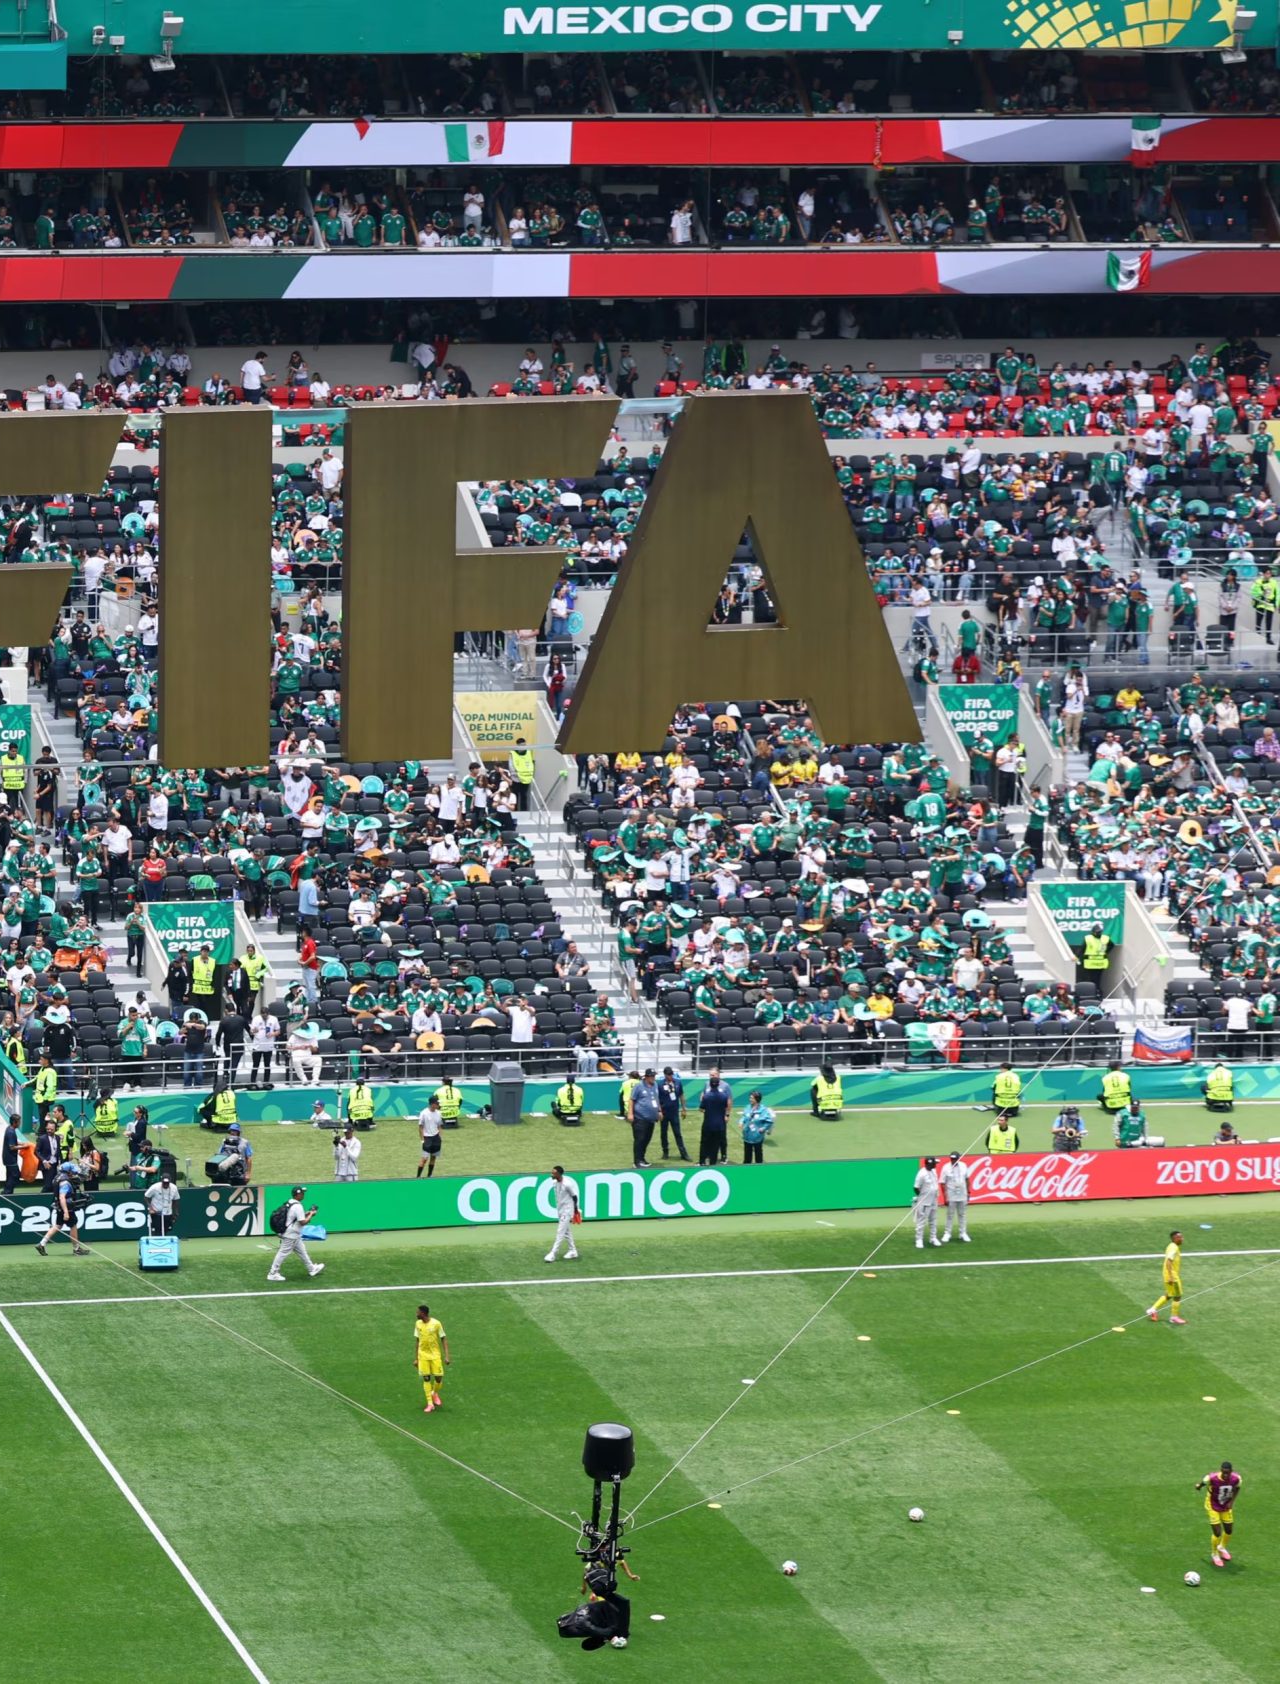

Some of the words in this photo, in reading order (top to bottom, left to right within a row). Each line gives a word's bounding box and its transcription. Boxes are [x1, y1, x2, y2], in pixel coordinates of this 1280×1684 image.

[503, 4, 733, 34] MEXICO
[745, 3, 883, 33] CITY
[934, 354, 985, 364] SALIDA
[1109, 458, 1119, 471] 11
[964, 699, 991, 708] FIFA
[462, 713, 486, 721] OPA
[488, 712, 534, 721] MUNDIAL
[988, 709, 1014, 720] CUP
[470, 723, 482, 731] DE
[485, 723, 497, 731] LA
[500, 722, 522, 730] FIFA
[955, 721, 999, 732] 2026
[1, 729, 26, 740] CUP
[477, 732, 513, 741] 2026
[924, 802, 938, 817] 18
[1067, 896, 1096, 907] FIFA
[1093, 908, 1120, 919] CUP
[177, 916, 206, 927] FIFA
[156, 929, 202, 940] WORLD
[204, 928, 230, 938] CUP
[1156, 1158, 1230, 1184] zero
[966, 1153, 1097, 1201] Coca-Cola
[457, 1169, 730, 1222] aramco
